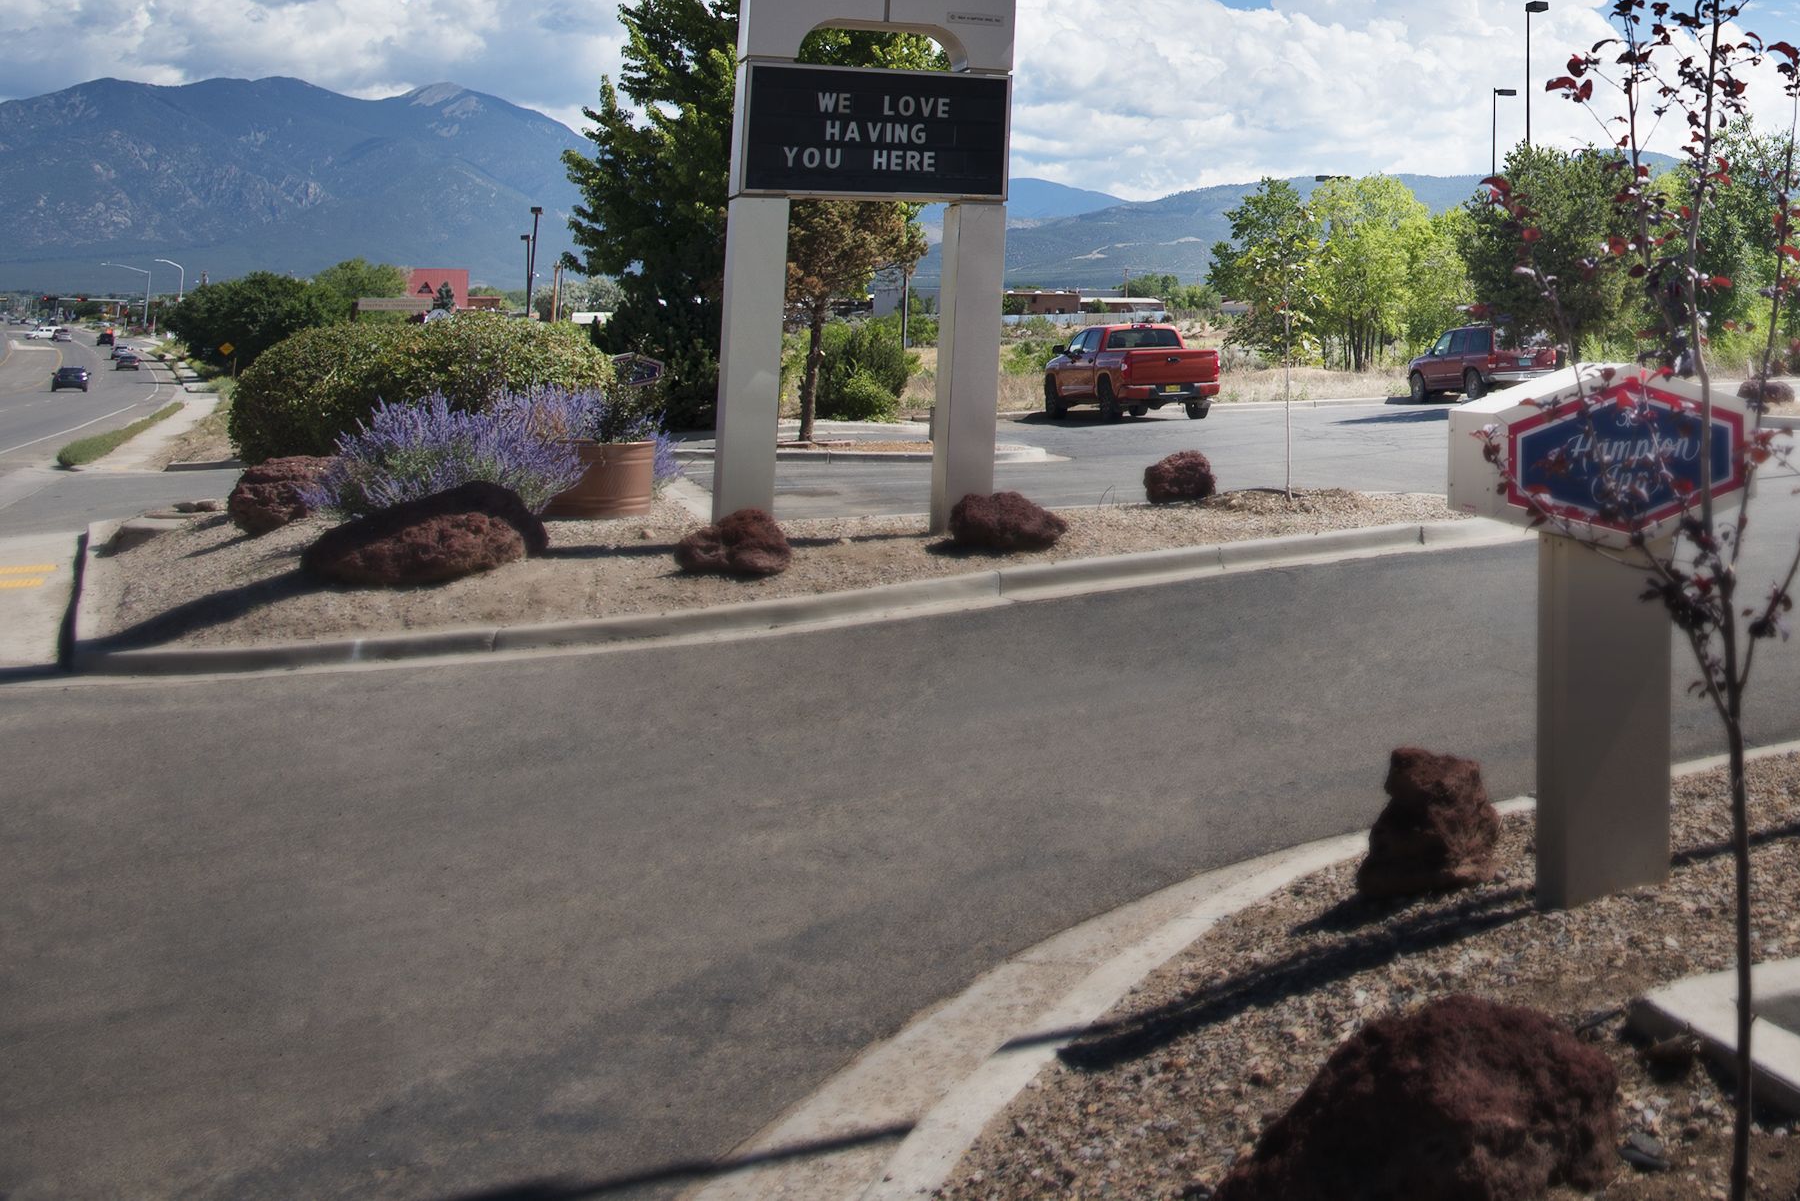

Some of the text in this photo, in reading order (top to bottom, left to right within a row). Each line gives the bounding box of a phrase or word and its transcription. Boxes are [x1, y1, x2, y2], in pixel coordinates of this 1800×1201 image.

[818, 92, 950, 118] WE LOVE
[825, 120, 926, 144] HAVING
[783, 146, 936, 172] YOU HERE
